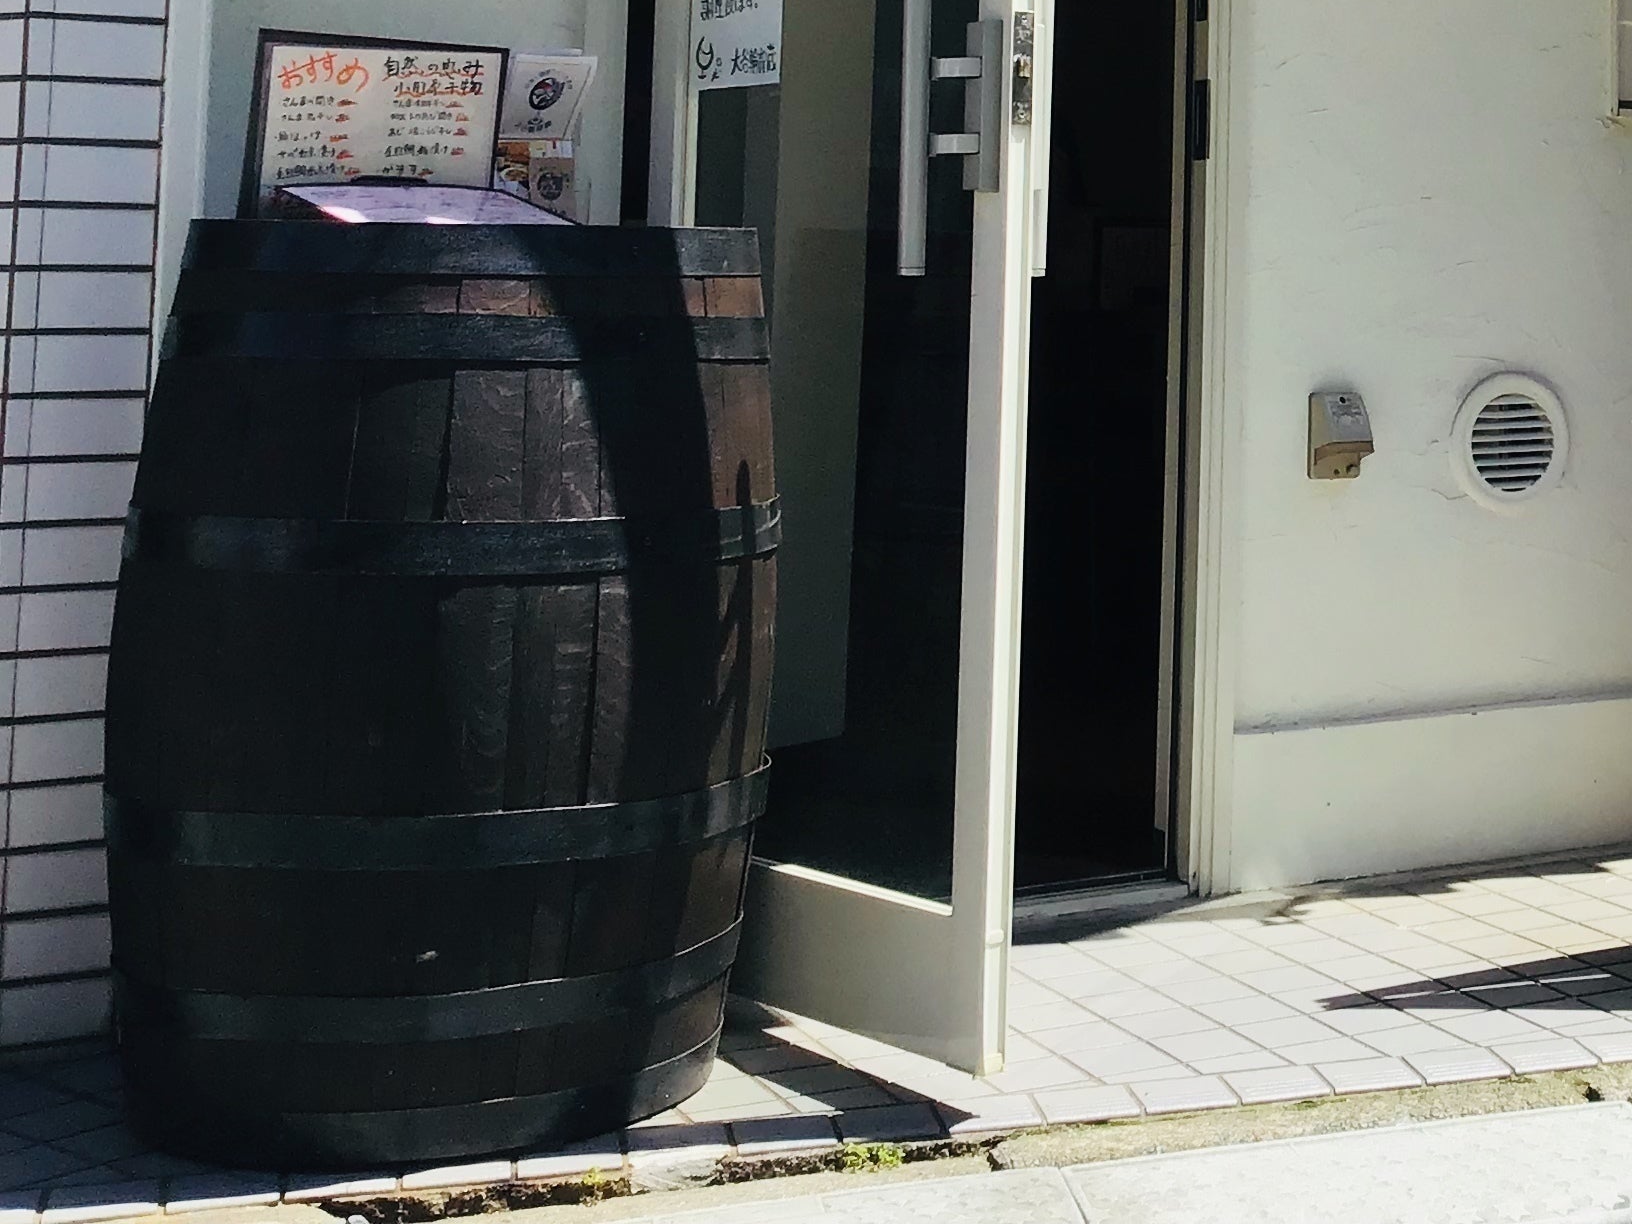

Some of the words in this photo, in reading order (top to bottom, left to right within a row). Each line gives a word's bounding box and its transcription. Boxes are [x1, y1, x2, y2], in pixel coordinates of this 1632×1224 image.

[277, 51, 370, 93] おすすめ
[384, 56, 485, 80] 自然の恵み
